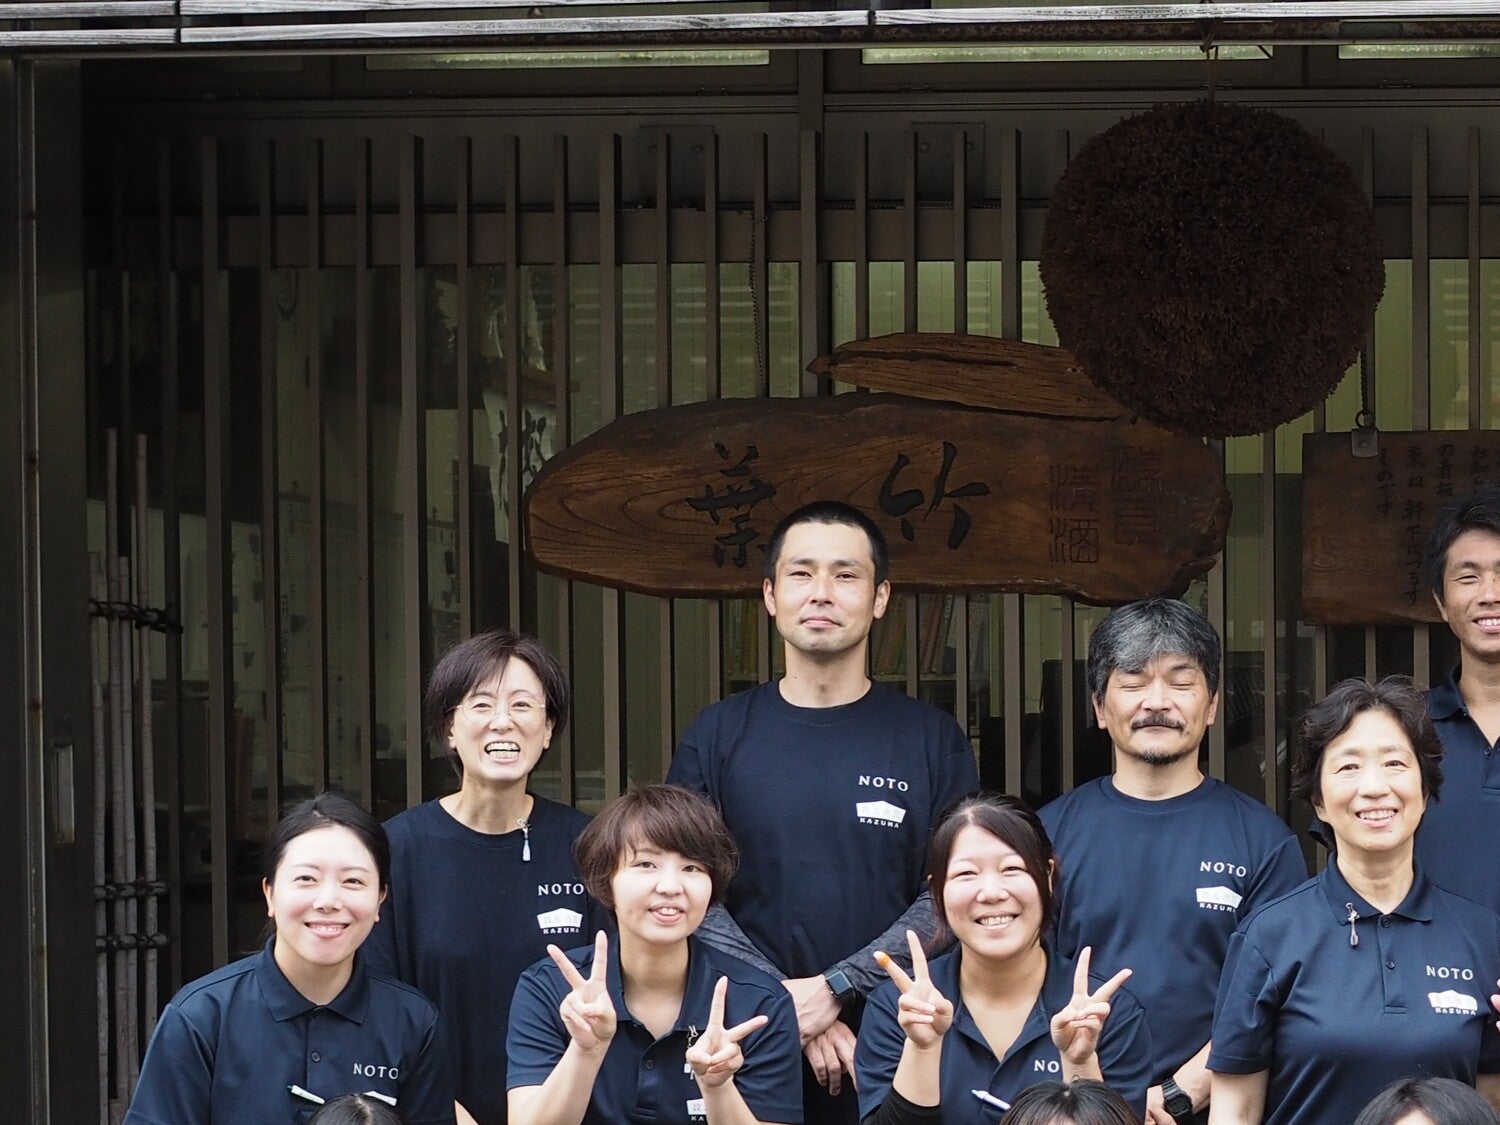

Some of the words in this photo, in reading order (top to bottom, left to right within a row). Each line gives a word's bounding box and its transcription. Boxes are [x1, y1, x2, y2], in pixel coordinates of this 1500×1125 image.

[858, 774, 909, 792] NOTO
[859, 817, 900, 829] KAZUMA
[1199, 860, 1247, 878] NOTO
[537, 883, 585, 896] NOTO
[1425, 964, 1474, 981] NOTO
[1435, 1007, 1477, 1016] KAZUMA
[352, 1062, 400, 1080] NOTO
[1033, 1059, 1060, 1073] NO
